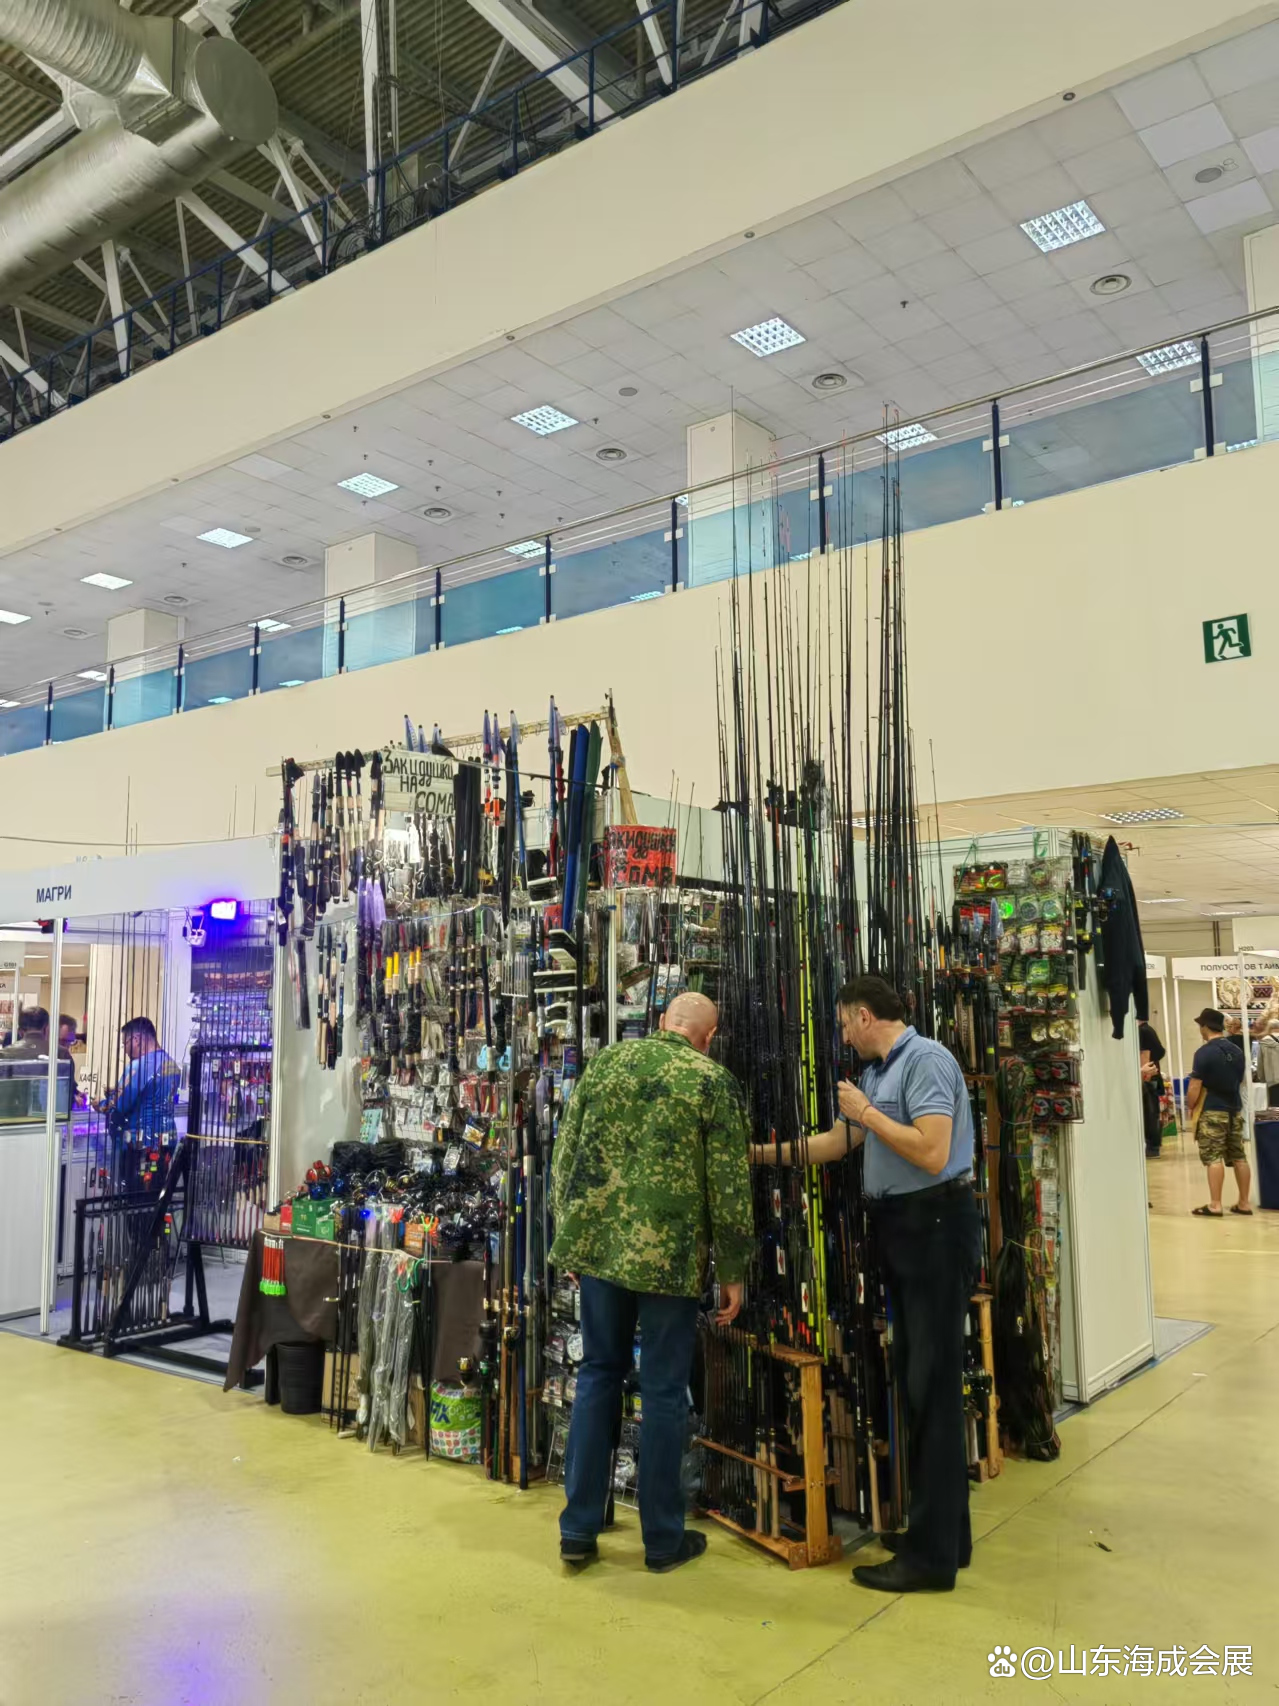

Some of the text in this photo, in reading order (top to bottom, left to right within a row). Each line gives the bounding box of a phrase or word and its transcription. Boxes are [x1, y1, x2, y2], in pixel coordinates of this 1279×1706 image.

[400, 775, 418, 793] НА
[415, 791, 454, 814] СОМА
[36, 884, 72, 903] МАГРИ
[1200, 963, 1257, 972] ПОЛУОСТОВ
